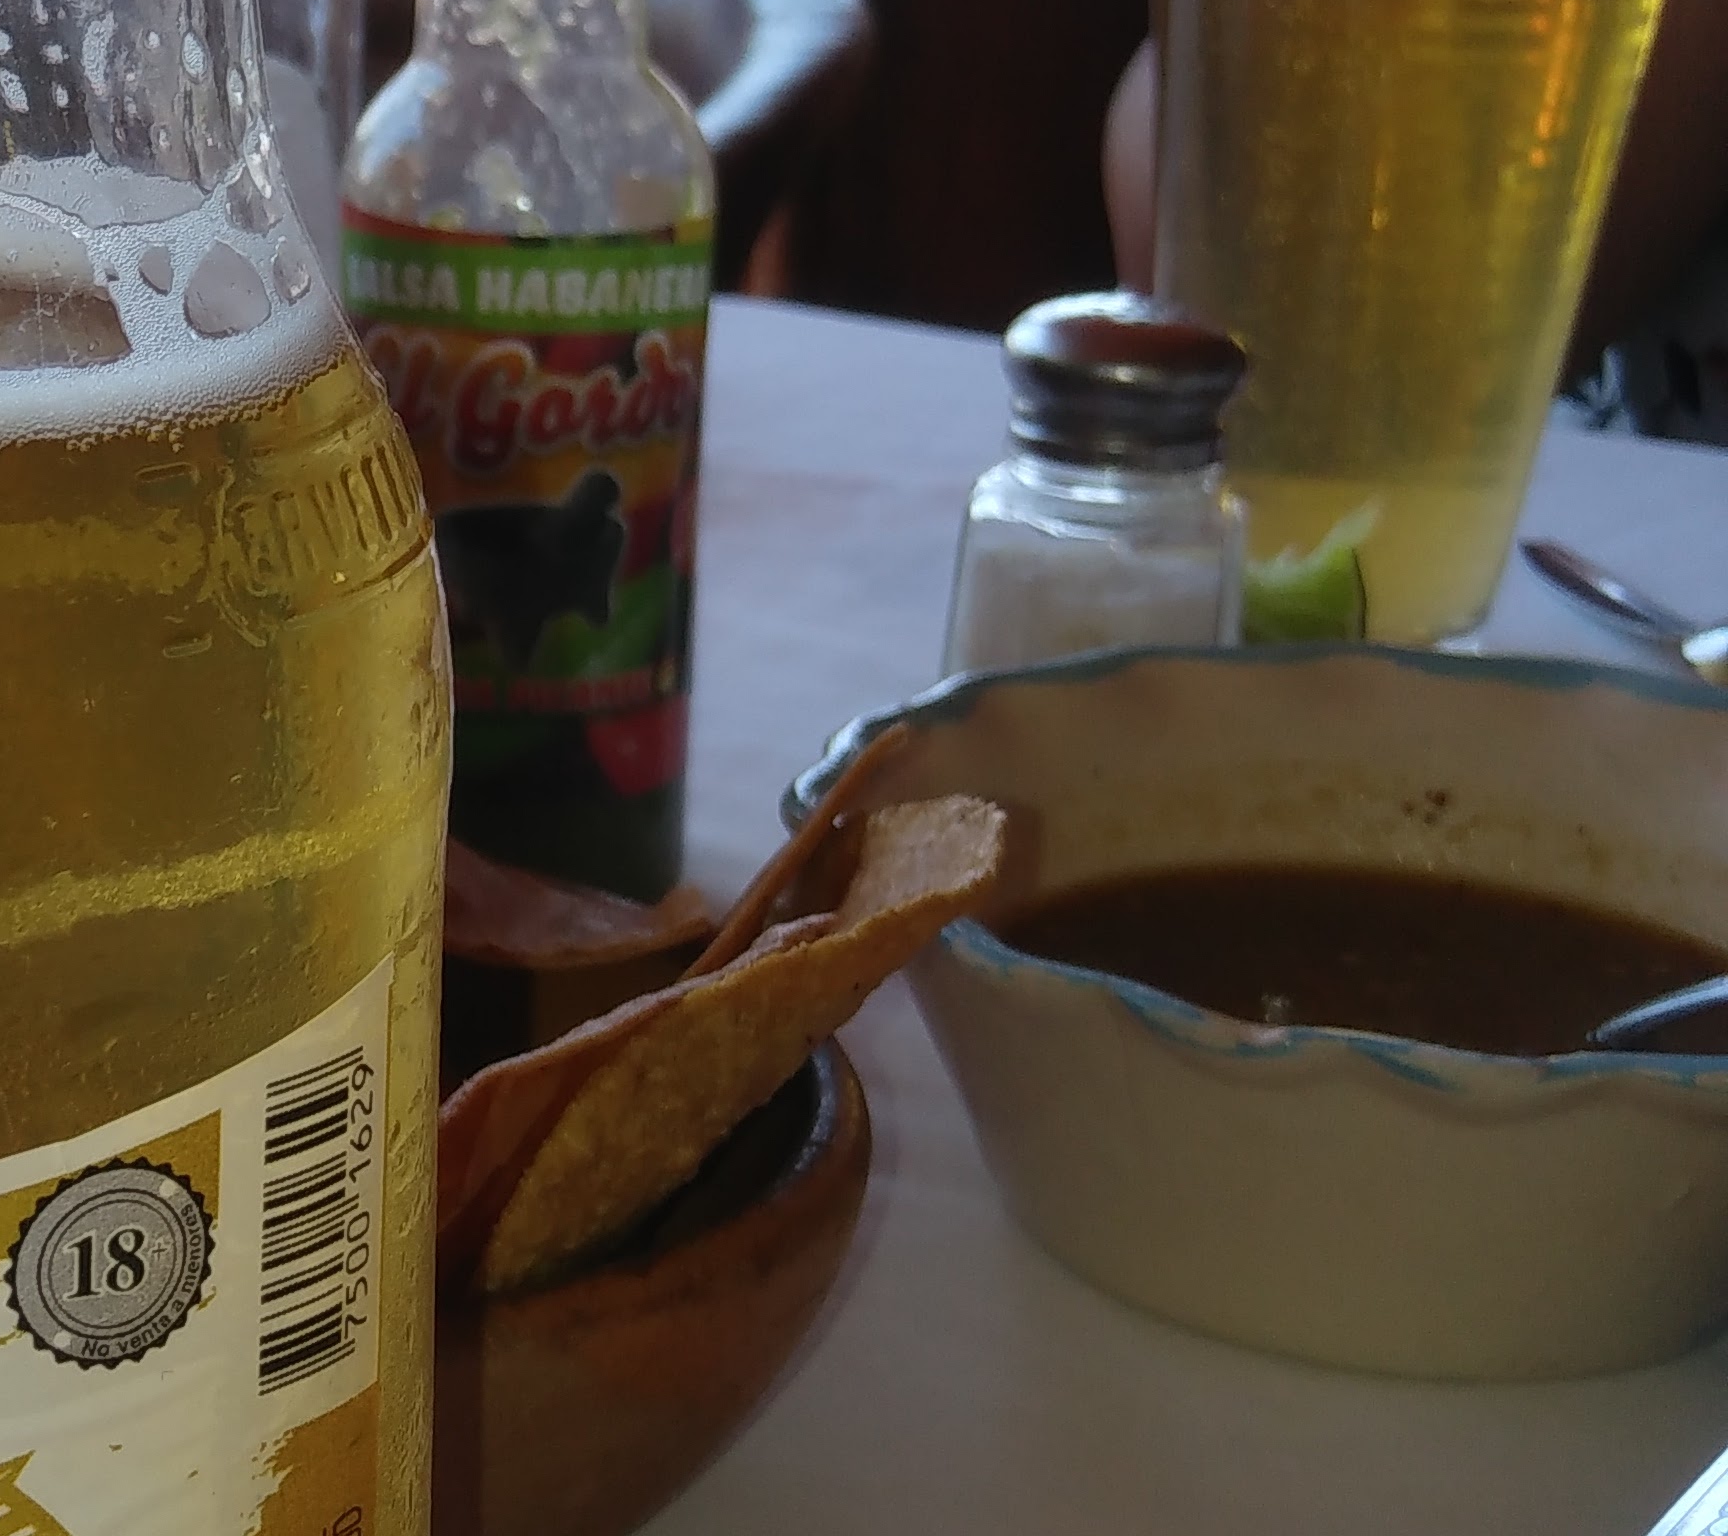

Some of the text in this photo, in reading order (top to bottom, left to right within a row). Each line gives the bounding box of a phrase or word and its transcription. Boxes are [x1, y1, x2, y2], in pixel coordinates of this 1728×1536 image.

[81, 1204, 202, 1357] No venta a menores
